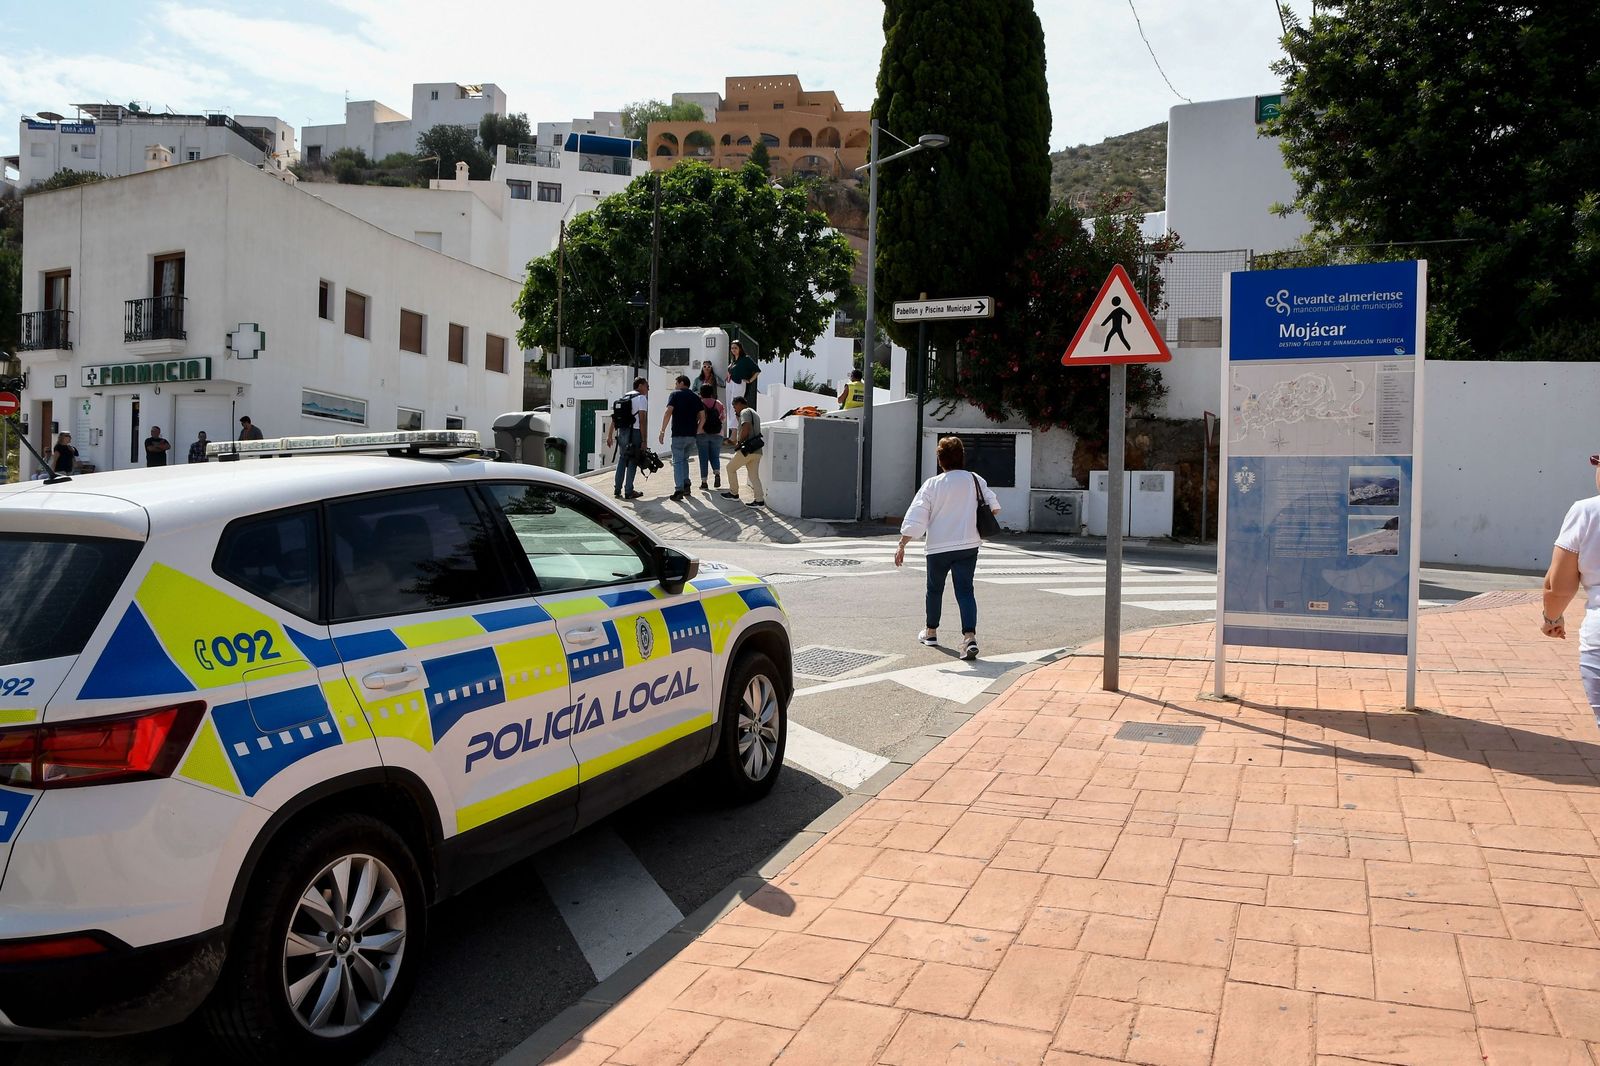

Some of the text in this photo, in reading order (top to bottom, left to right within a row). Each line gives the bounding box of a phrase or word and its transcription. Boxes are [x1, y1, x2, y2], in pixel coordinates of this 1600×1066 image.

[1293, 290, 1403, 305] levante almeriense
[1293, 301, 1403, 313] mancomunidad de municipios
[896, 307, 918, 315] Pabellón
[919, 308, 923, 316] y
[946, 304, 972, 314] Municipal
[1279, 322, 1346, 341] Mojácar
[1333, 338, 1374, 346] DINAMIZACIÓN
[1376, 336, 1404, 344] TURÍSTICA
[99, 360, 201, 385] FARMACIA
[211, 629, 282, 667] 092
[0, 677, 35, 696] 92
[465, 666, 700, 773] POLICÍA LOCAL
